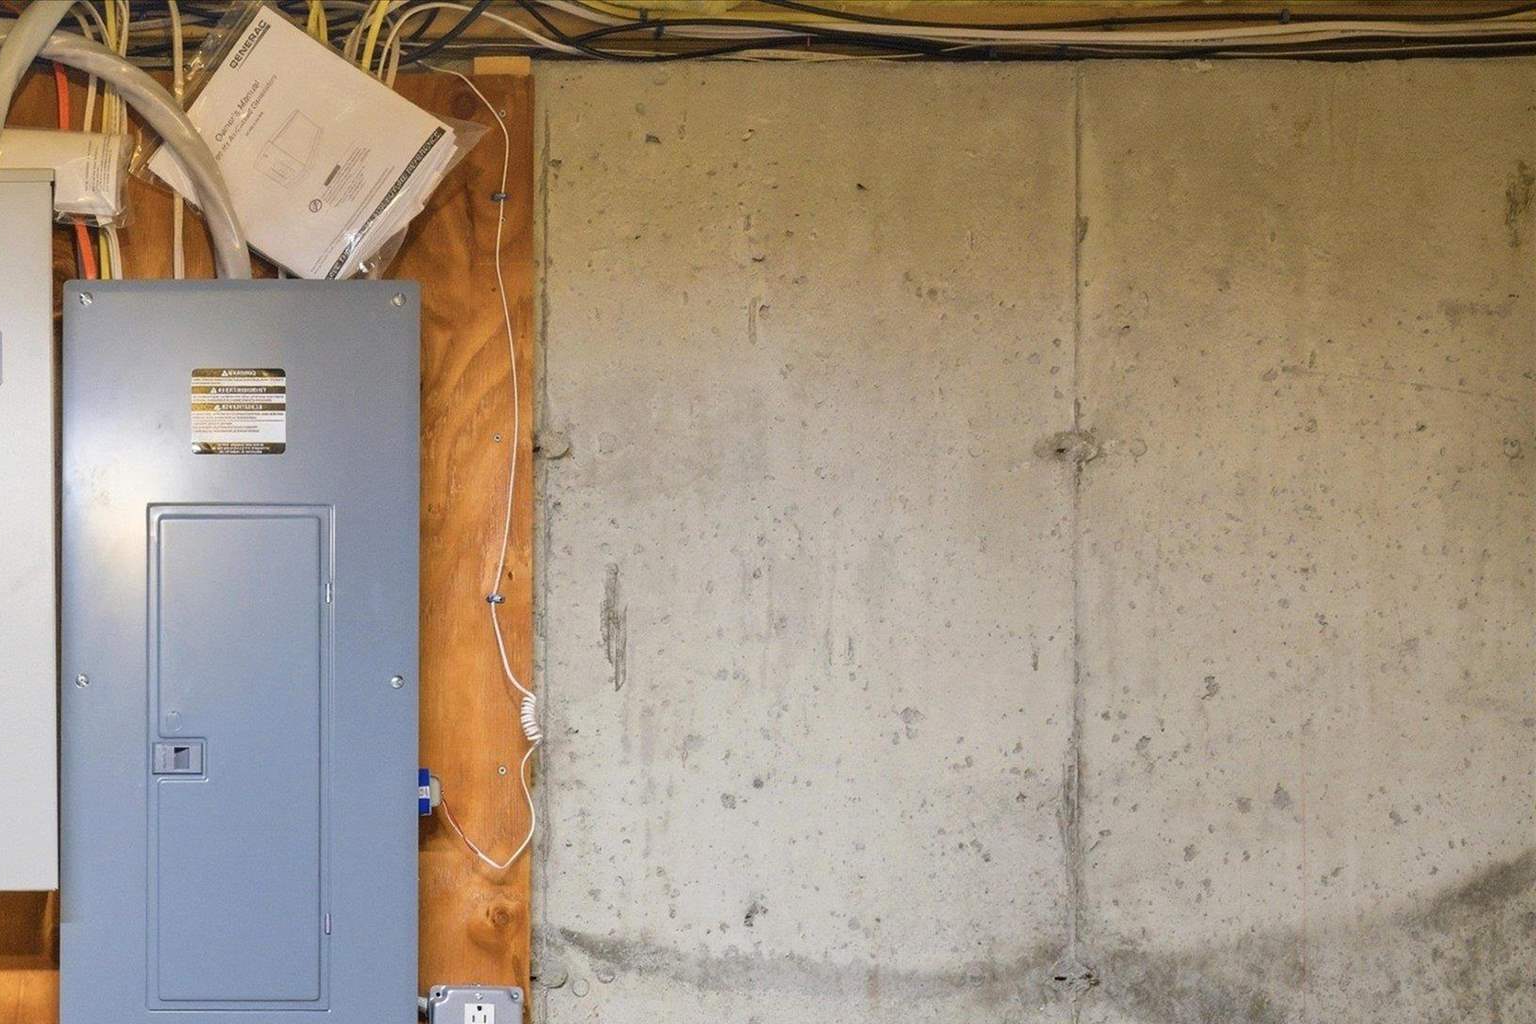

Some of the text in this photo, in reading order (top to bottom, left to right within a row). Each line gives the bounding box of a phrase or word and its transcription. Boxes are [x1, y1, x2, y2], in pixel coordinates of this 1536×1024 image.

[230, 19, 269, 70] GENERAC
[215, 109, 241, 143] Owner's
[237, 79, 262, 110] Manual
